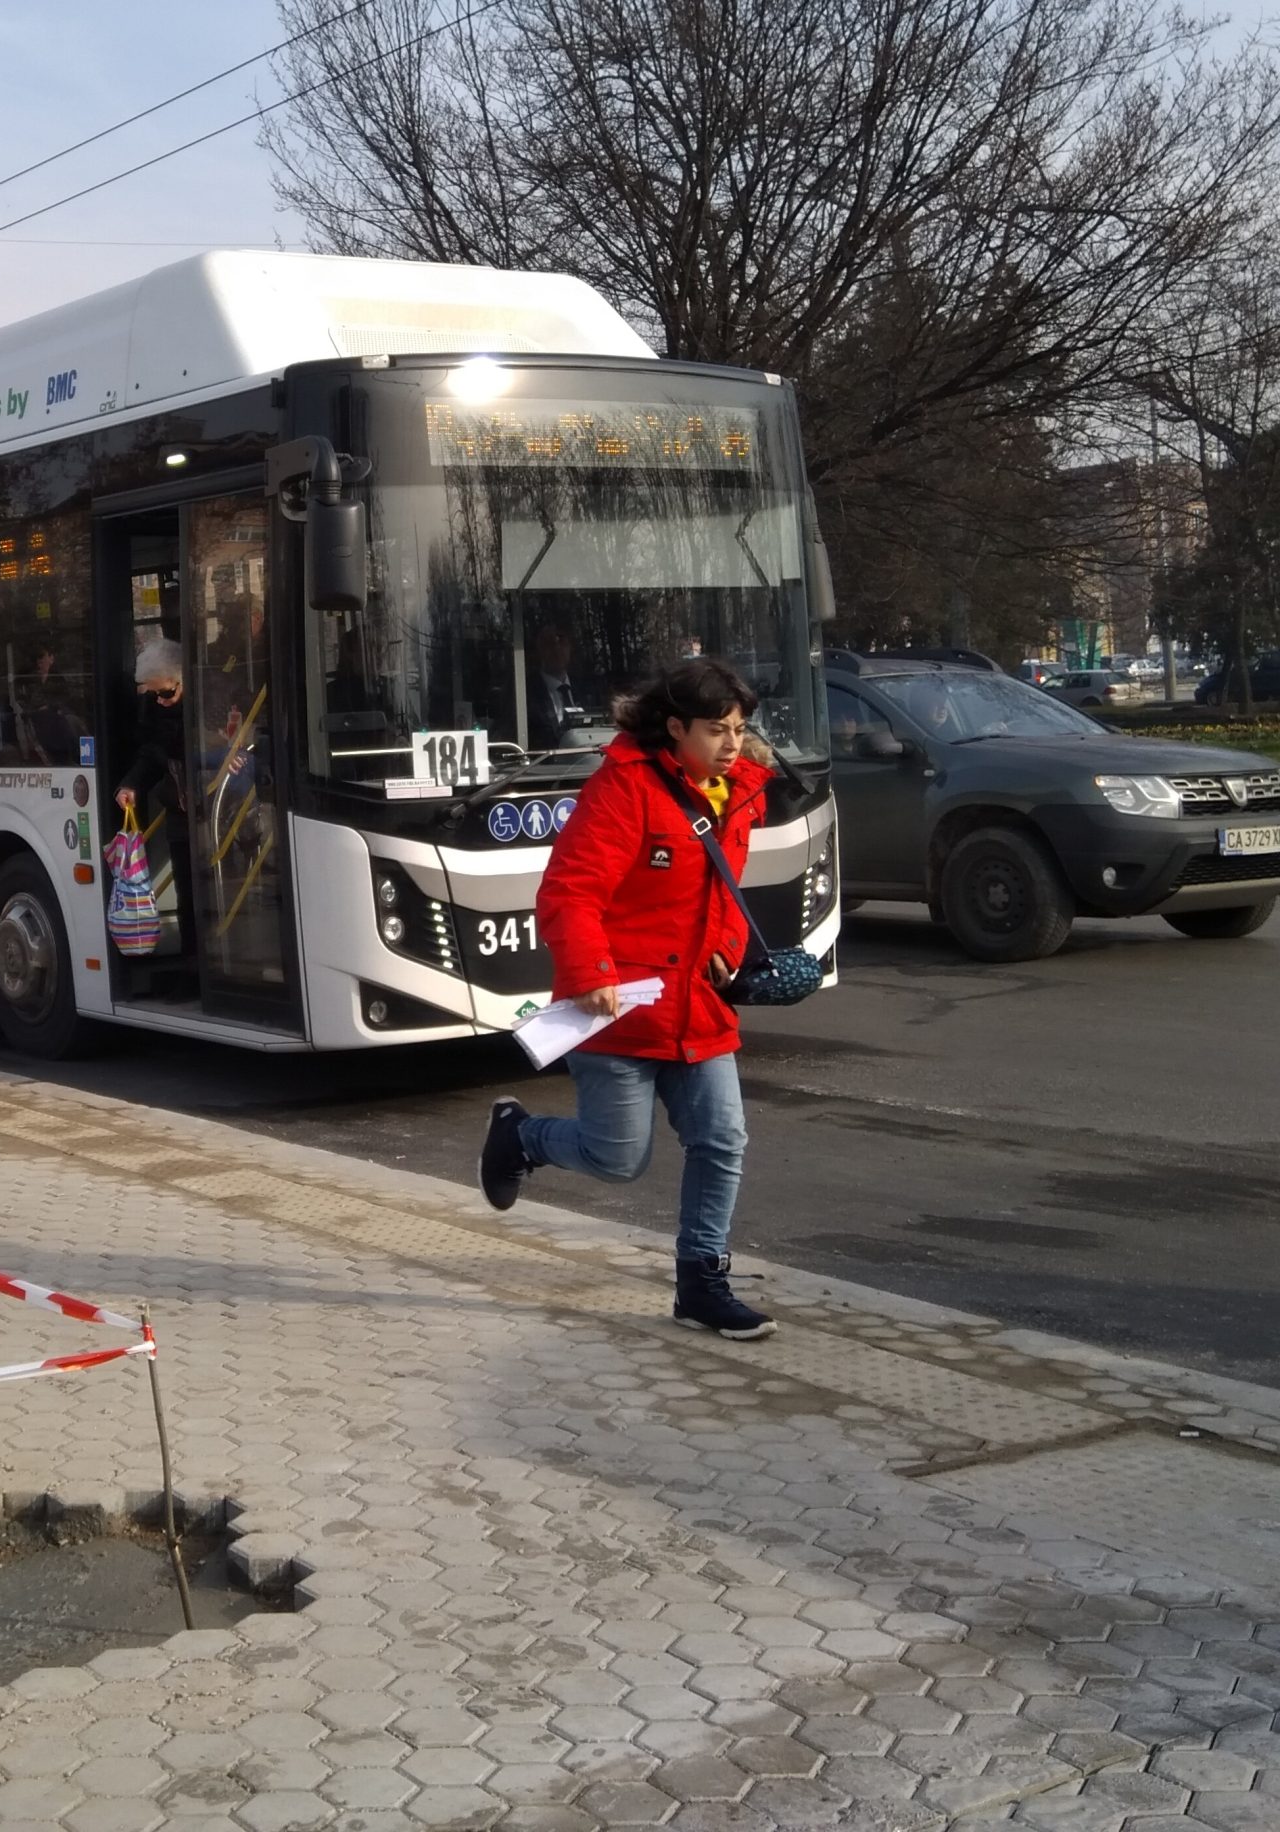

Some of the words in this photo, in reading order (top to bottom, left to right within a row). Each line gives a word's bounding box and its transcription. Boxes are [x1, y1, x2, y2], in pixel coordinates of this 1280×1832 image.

[7, 388, 29, 419] by
[46, 369, 77, 405] BMC
[423, 735, 478, 786] 184
[1227, 831, 1243, 848] CA
[1245, 829, 1270, 847] 3729
[478, 914, 548, 956] 341
